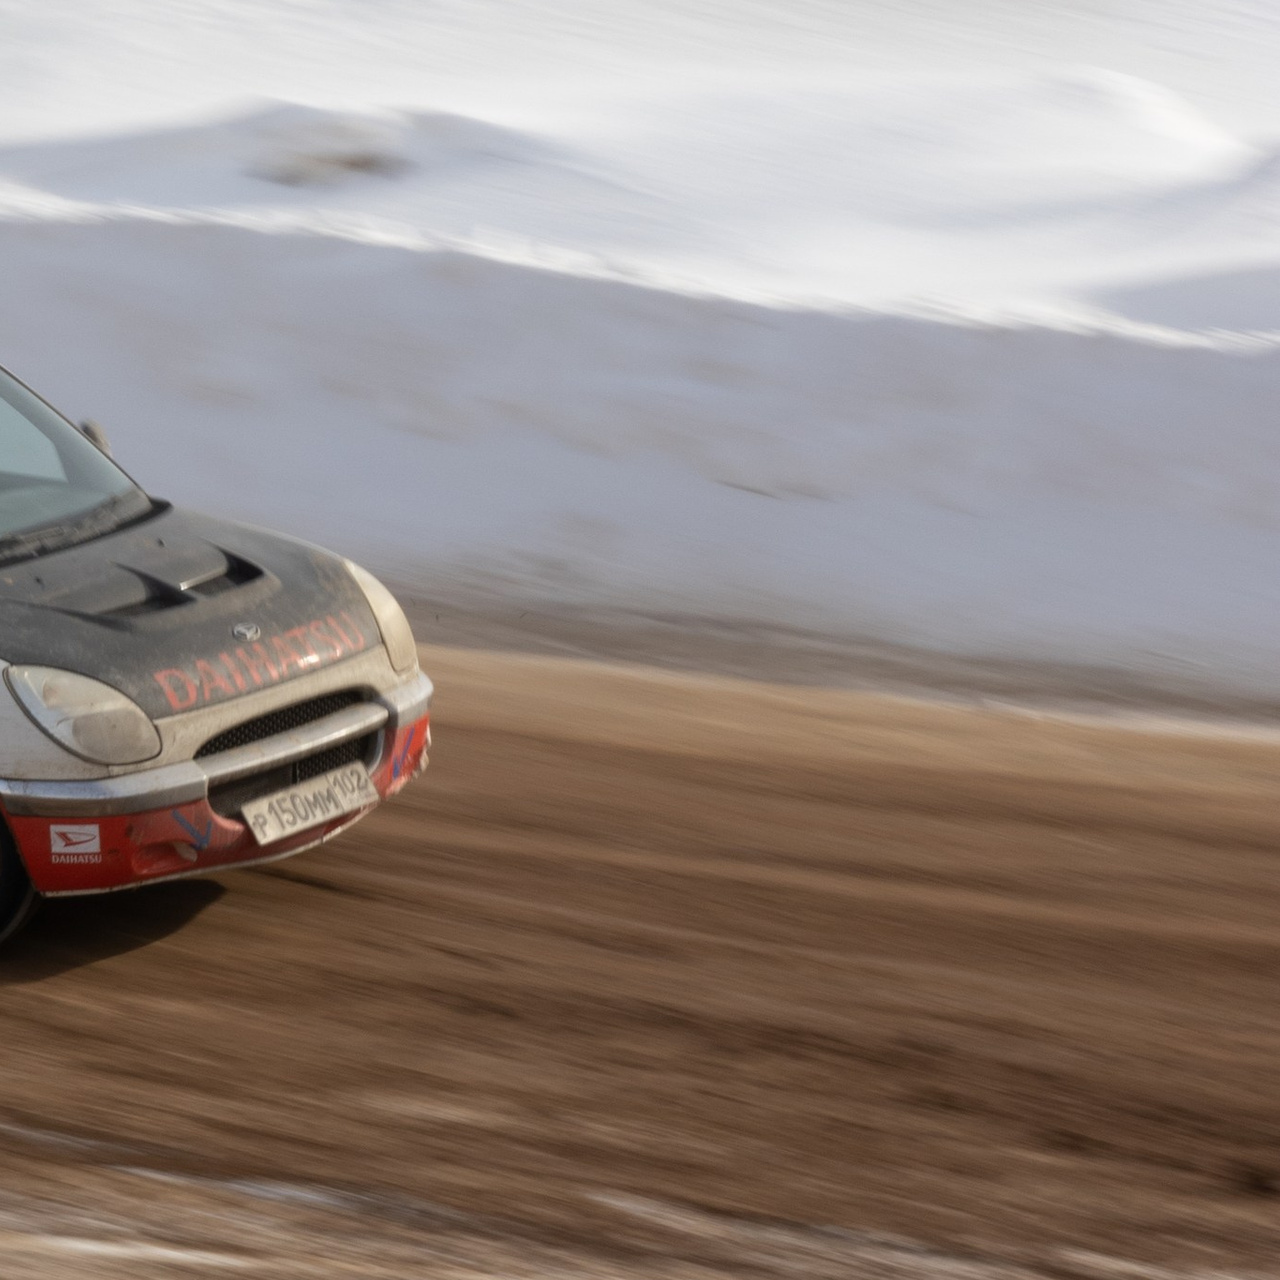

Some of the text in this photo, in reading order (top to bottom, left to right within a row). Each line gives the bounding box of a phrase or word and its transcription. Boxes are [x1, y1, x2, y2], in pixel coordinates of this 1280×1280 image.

[154, 610, 365, 711] DAIHATSU
[332, 768, 369, 800] 102
[51, 854, 103, 865] DAIHATSU
